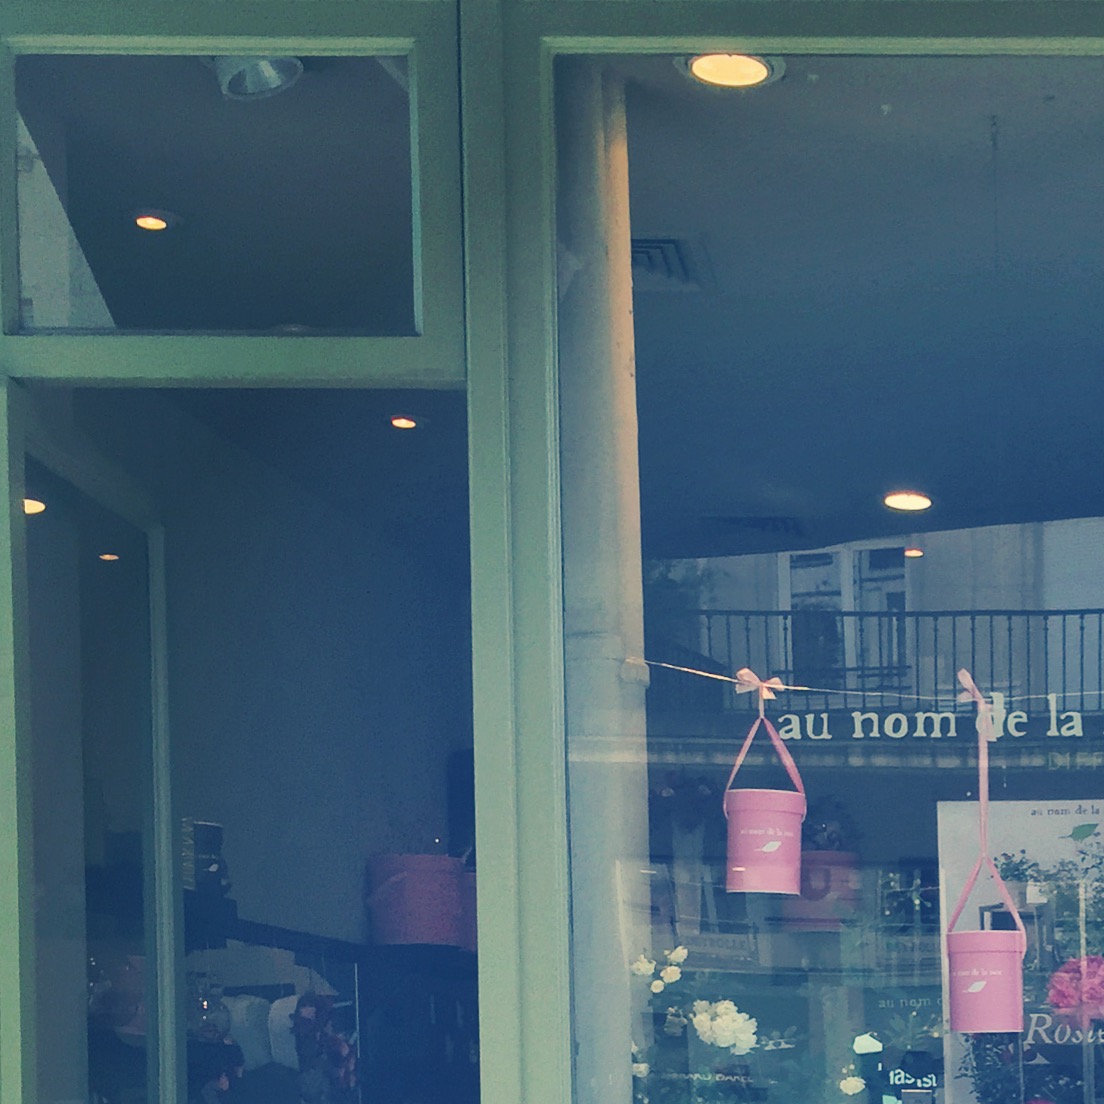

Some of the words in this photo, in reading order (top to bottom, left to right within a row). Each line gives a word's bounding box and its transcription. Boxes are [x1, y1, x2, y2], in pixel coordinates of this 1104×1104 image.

[778, 711, 832, 740] au
[852, 711, 957, 739] nom
[976, 692, 1028, 738] de
[1047, 693, 1083, 737] la
[1030, 808, 1043, 816] au
[1047, 808, 1071, 816] nom
[1075, 804, 1088, 816] de
[1091, 804, 1100, 815] la
[878, 999, 895, 1008] au
[900, 998, 931, 1008] nom
